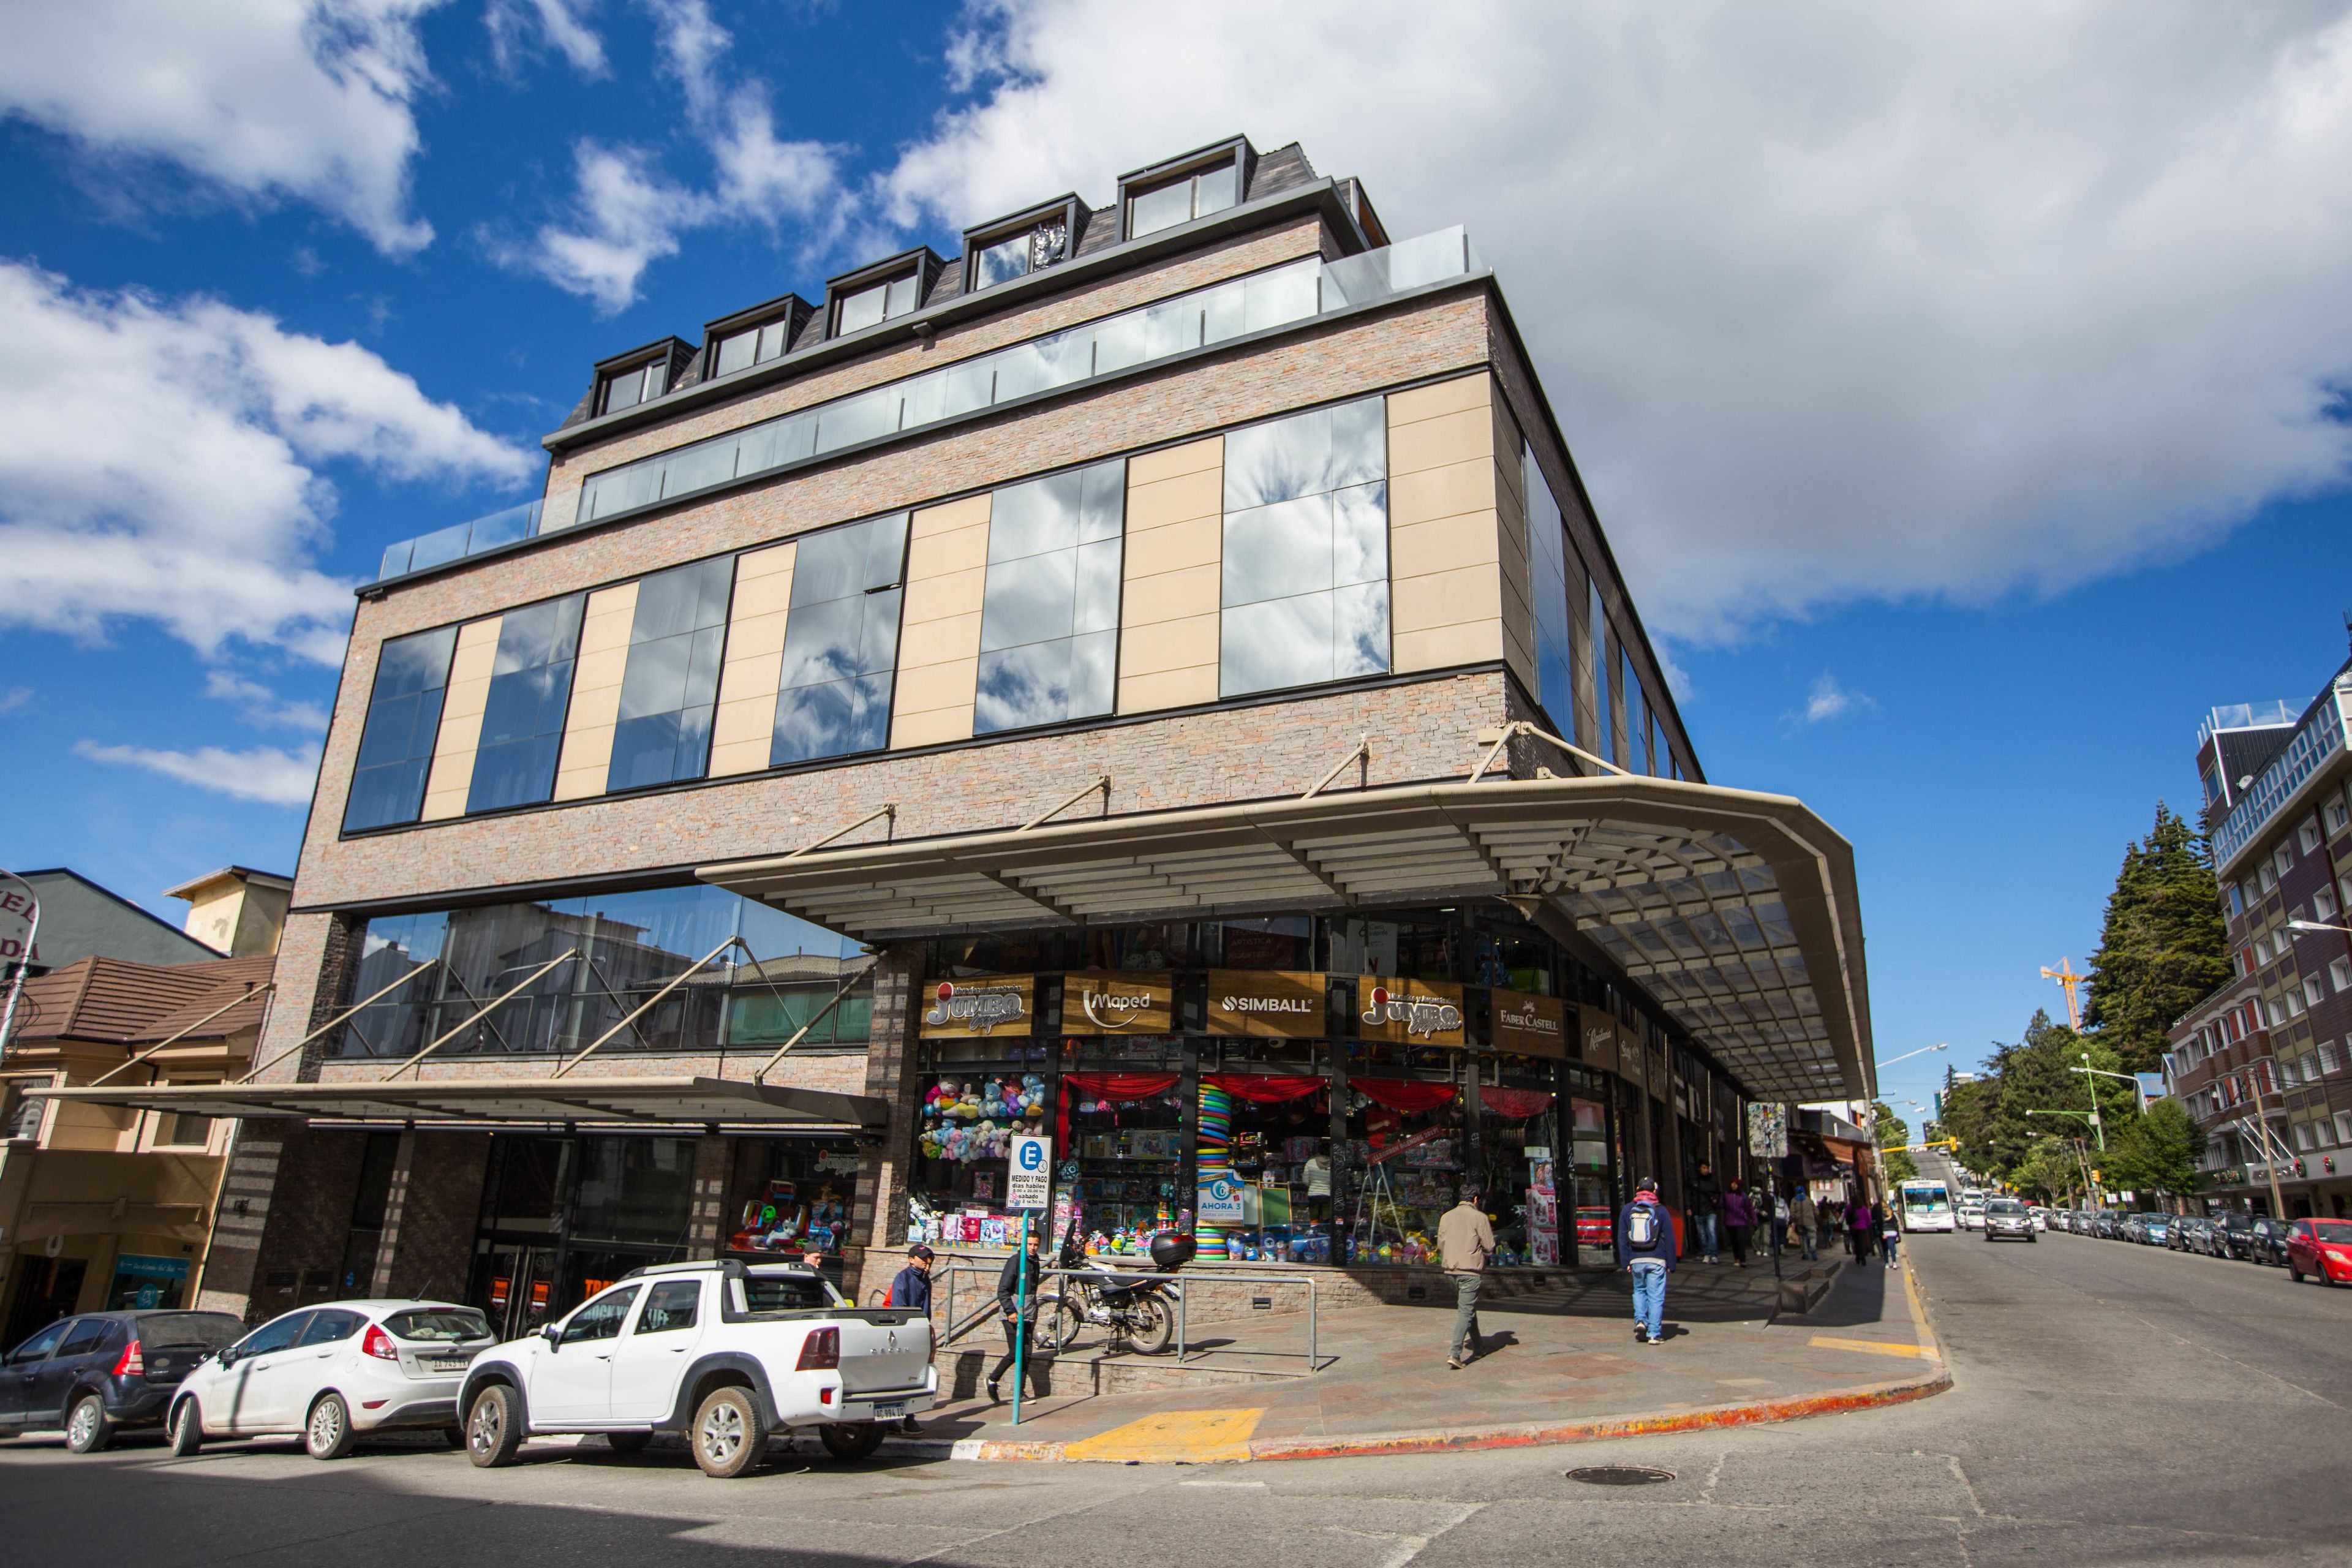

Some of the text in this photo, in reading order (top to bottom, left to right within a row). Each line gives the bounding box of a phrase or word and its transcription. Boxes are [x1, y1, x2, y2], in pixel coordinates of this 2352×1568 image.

[0, 891, 36, 924] EL
[1084, 990, 1150, 1014] Maped
[1237, 997, 1311, 1013] SIMBALL
[1499, 1009, 1559, 1031] FABER CASTELL
[1025, 1146, 1037, 1165] E
